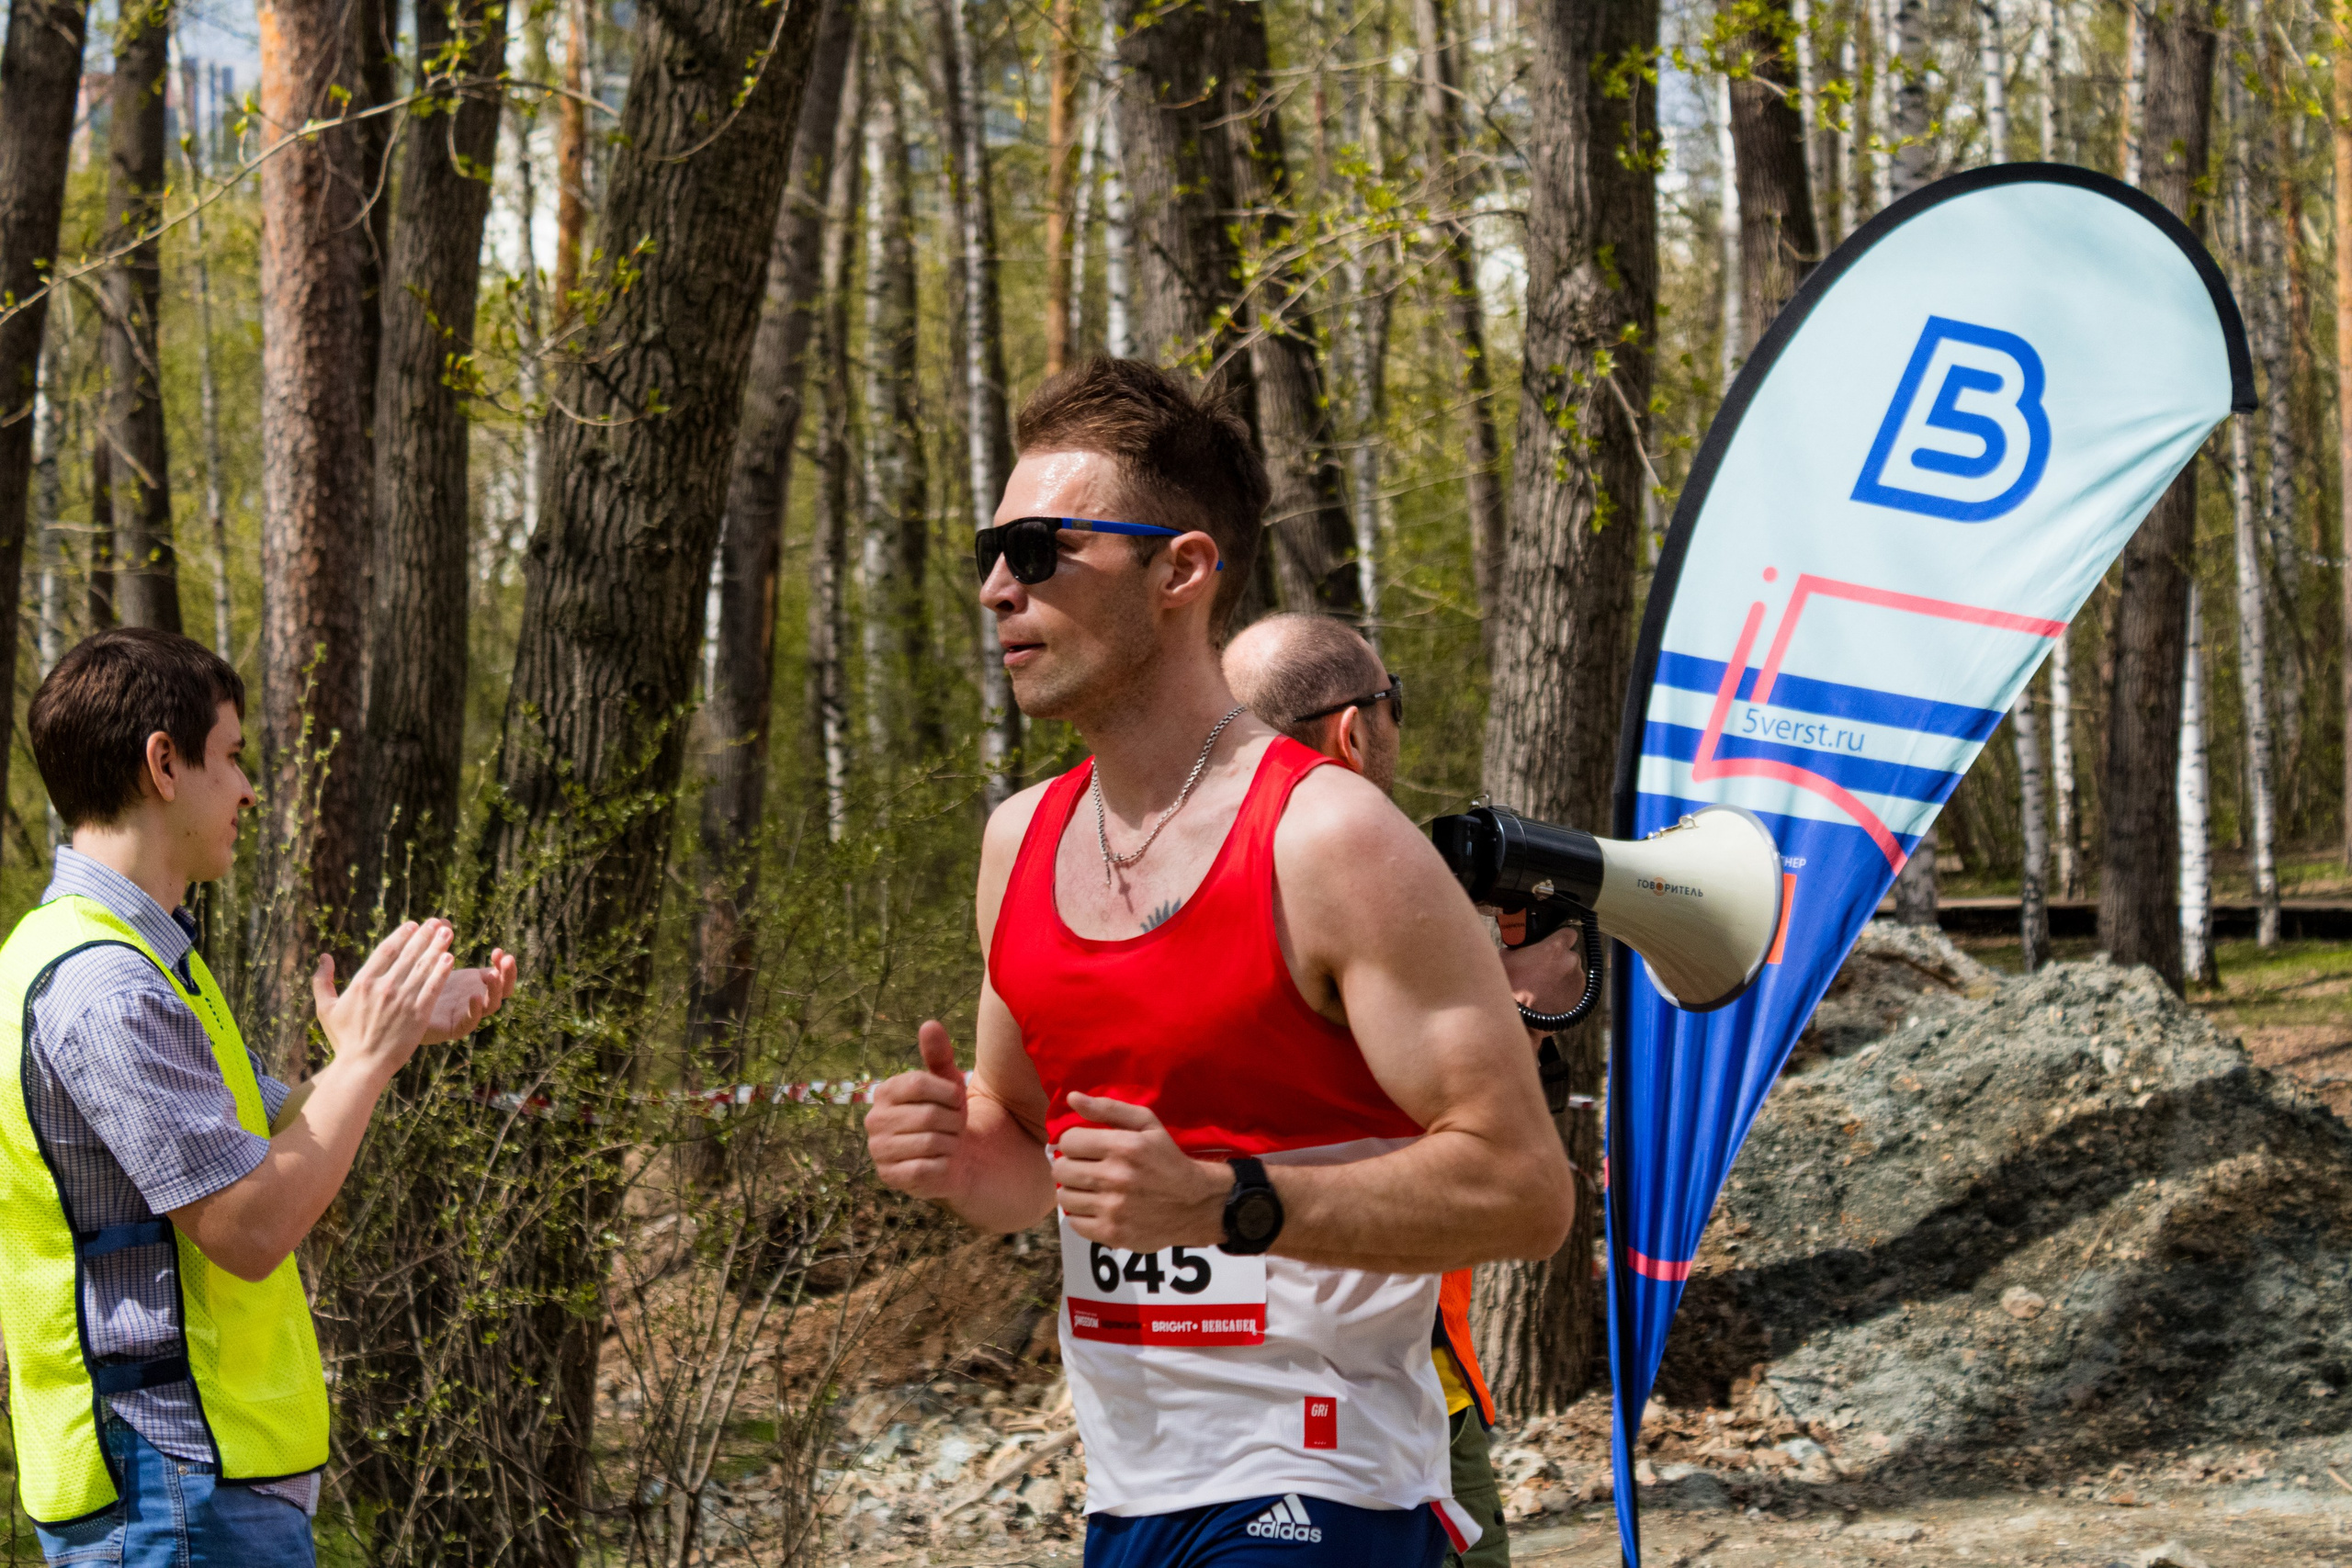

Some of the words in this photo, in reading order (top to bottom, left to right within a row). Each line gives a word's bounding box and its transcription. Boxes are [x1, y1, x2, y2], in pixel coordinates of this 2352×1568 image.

[1742, 707, 1865, 752] 5verst.ru
[1637, 878, 1703, 897] ГОВОРИТЕЛЬ
[1091, 1242, 1212, 1295] 645
[1246, 1520, 1322, 1543] adidas
